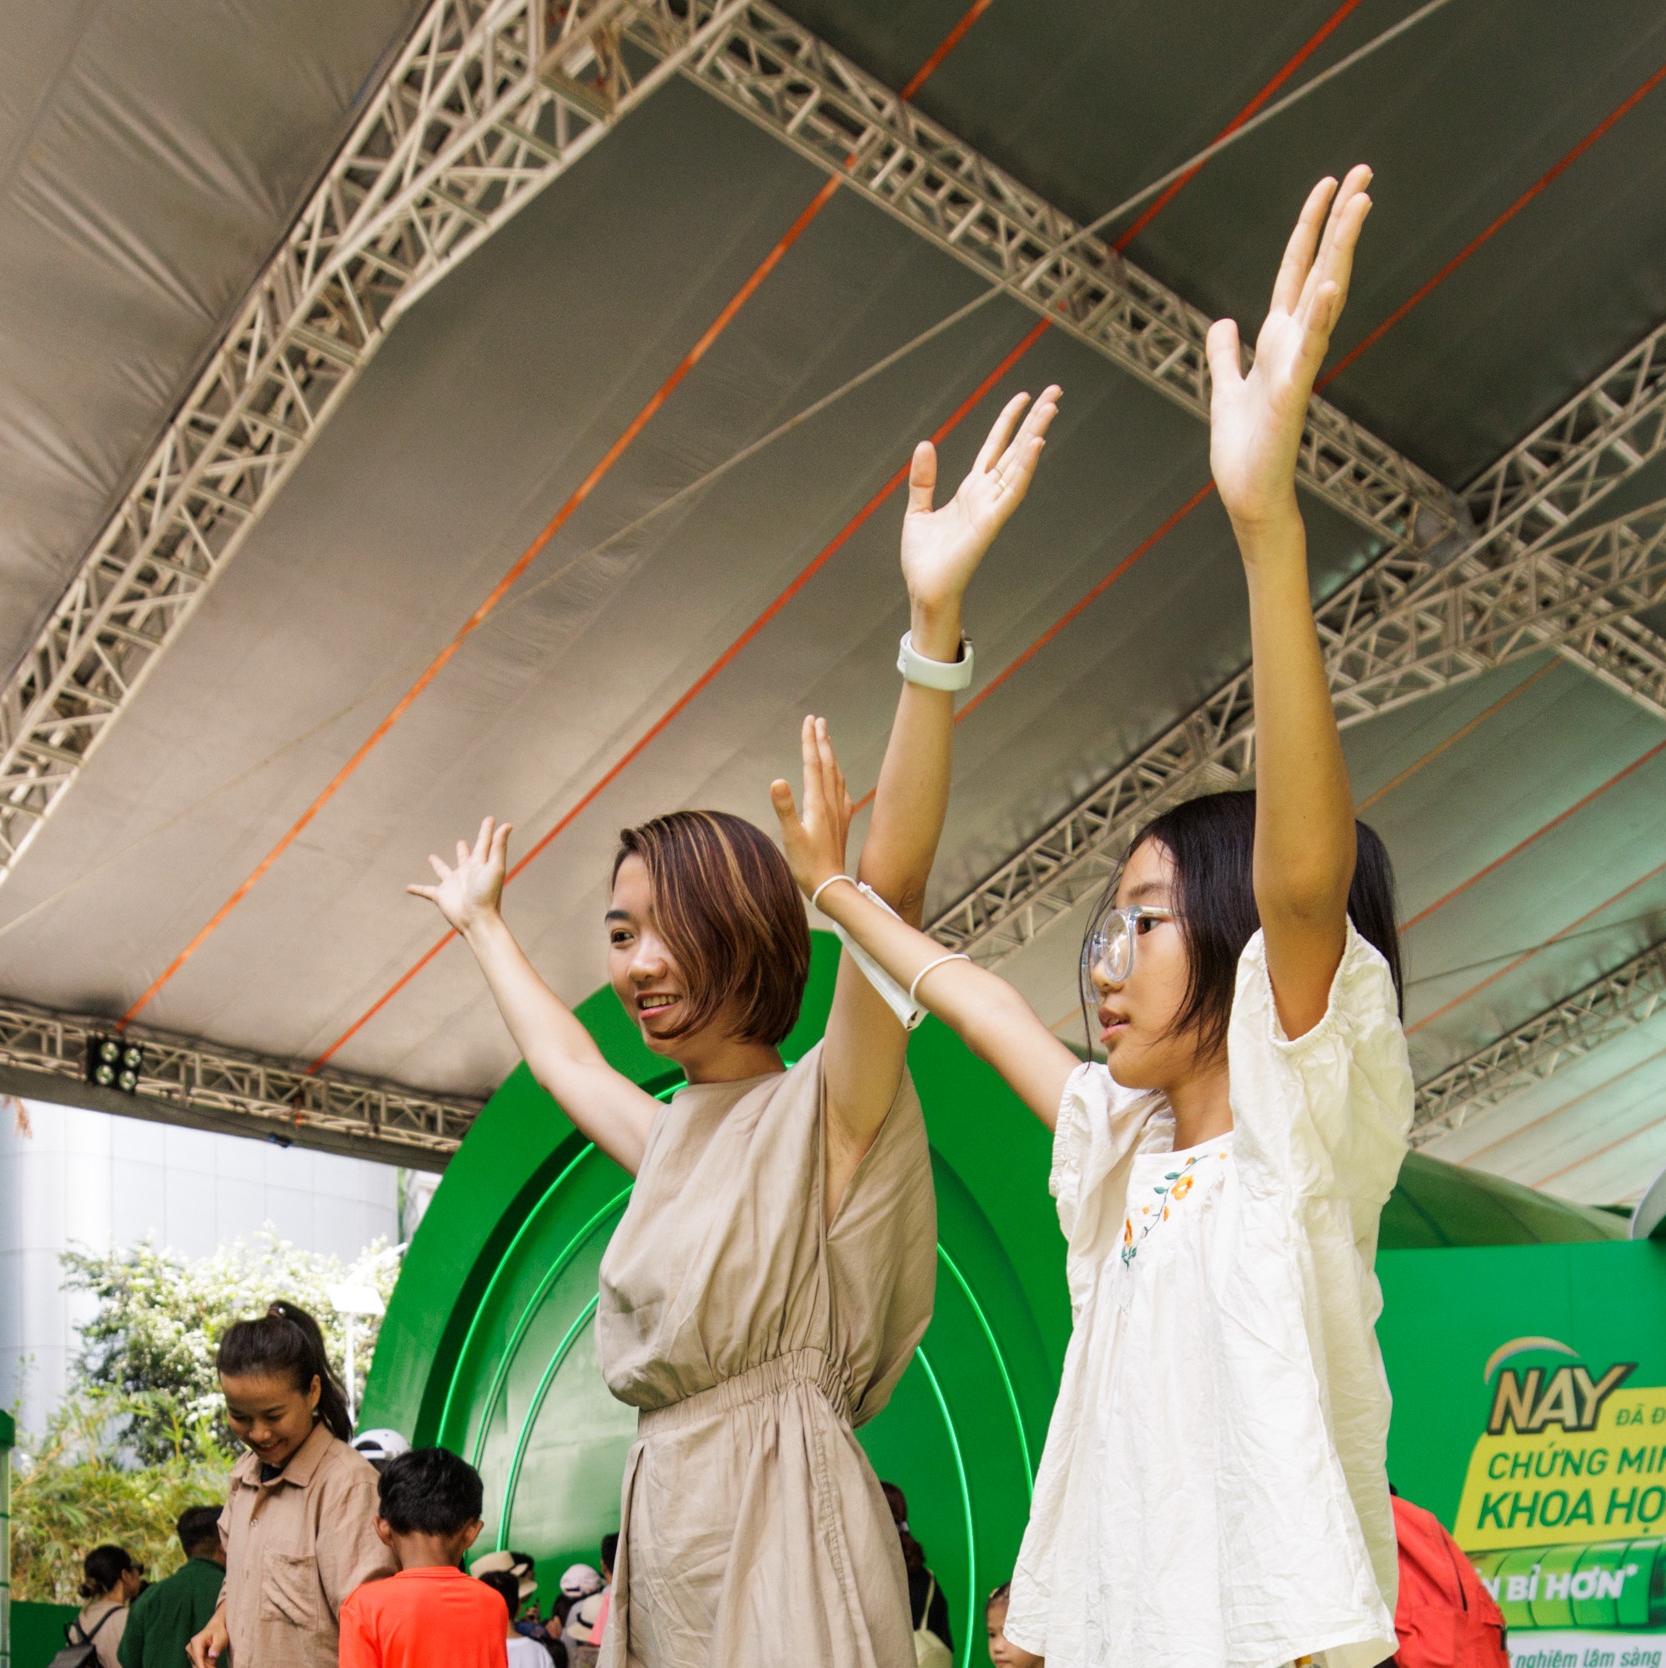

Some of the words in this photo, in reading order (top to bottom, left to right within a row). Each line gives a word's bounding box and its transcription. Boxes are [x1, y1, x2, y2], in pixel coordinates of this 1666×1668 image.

[1487, 1362, 1639, 1436] NAY
[1615, 1402, 1644, 1426] ĐÃ
[1488, 1441, 1609, 1480] CHỨNG
[1477, 1488, 1595, 1530] KHOA
[1506, 1563, 1542, 1602] BỈ
[1583, 1648, 1615, 1668] lâm
